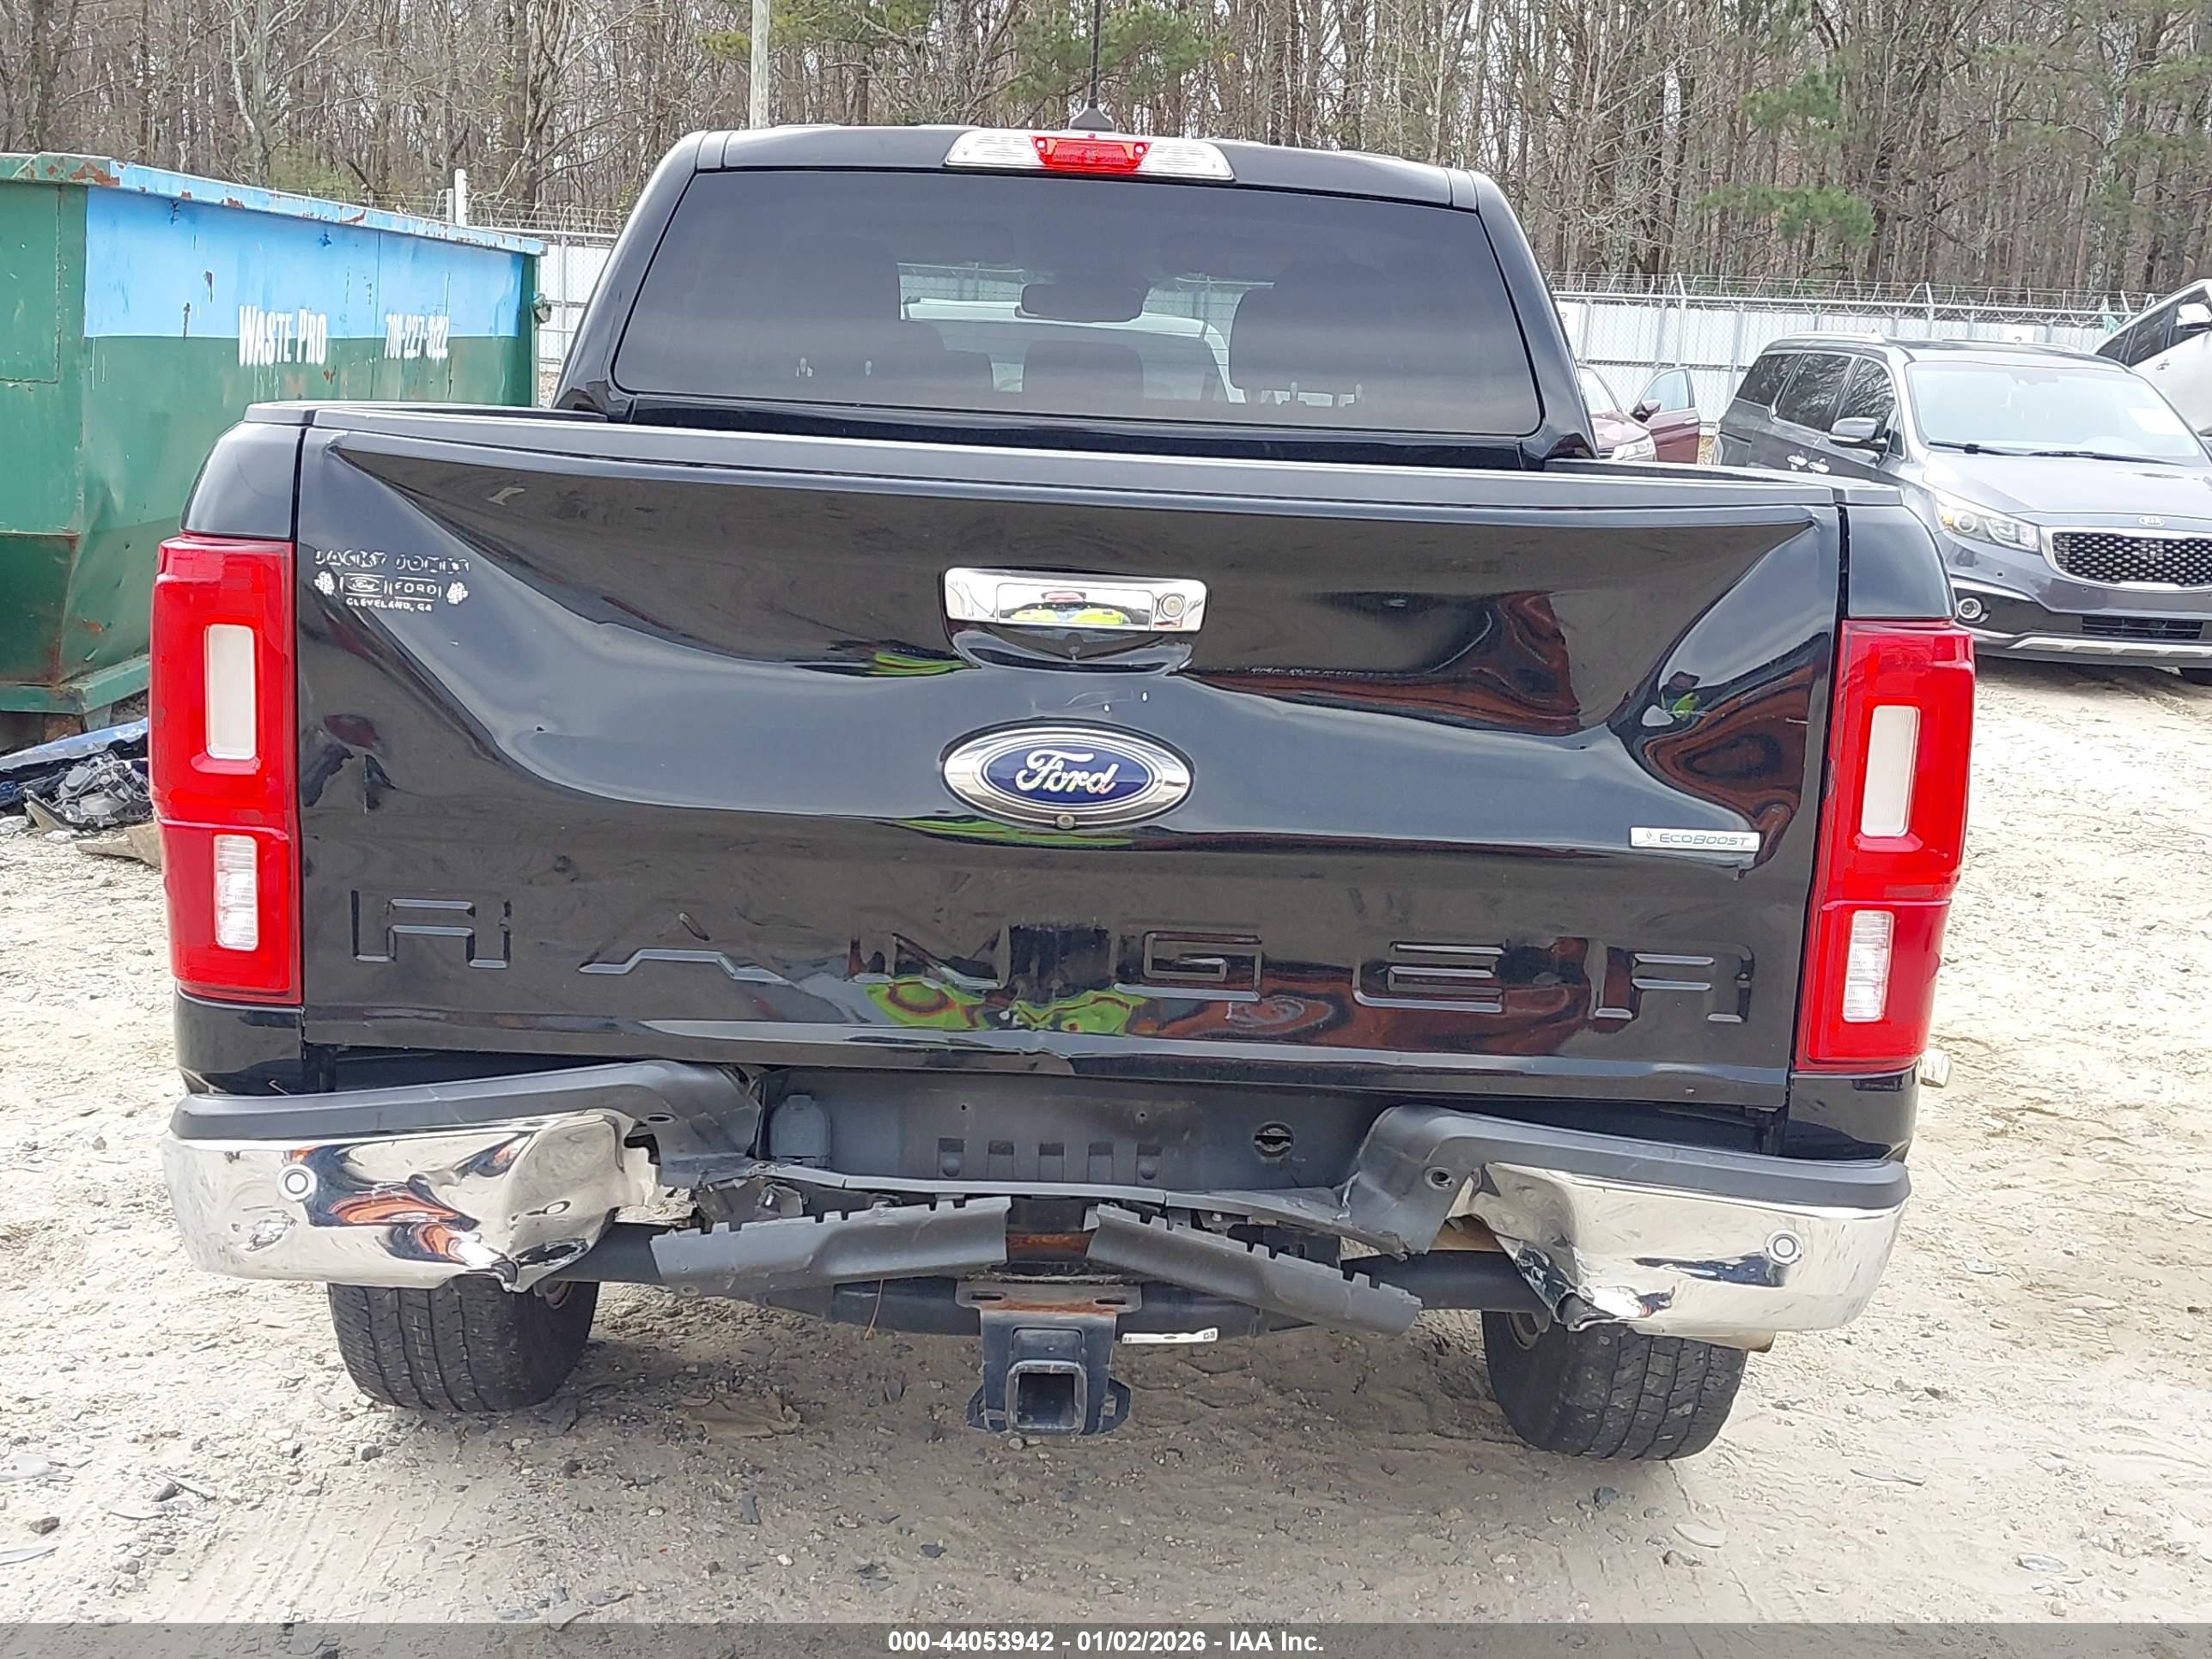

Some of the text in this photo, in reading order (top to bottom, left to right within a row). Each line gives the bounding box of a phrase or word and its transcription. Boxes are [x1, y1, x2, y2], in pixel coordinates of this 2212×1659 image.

[239, 305, 326, 366] WASTE PRO
[394, 582, 437, 595] FORD
[416, 603, 433, 612] GA
[1015, 749, 1120, 794] Ford
